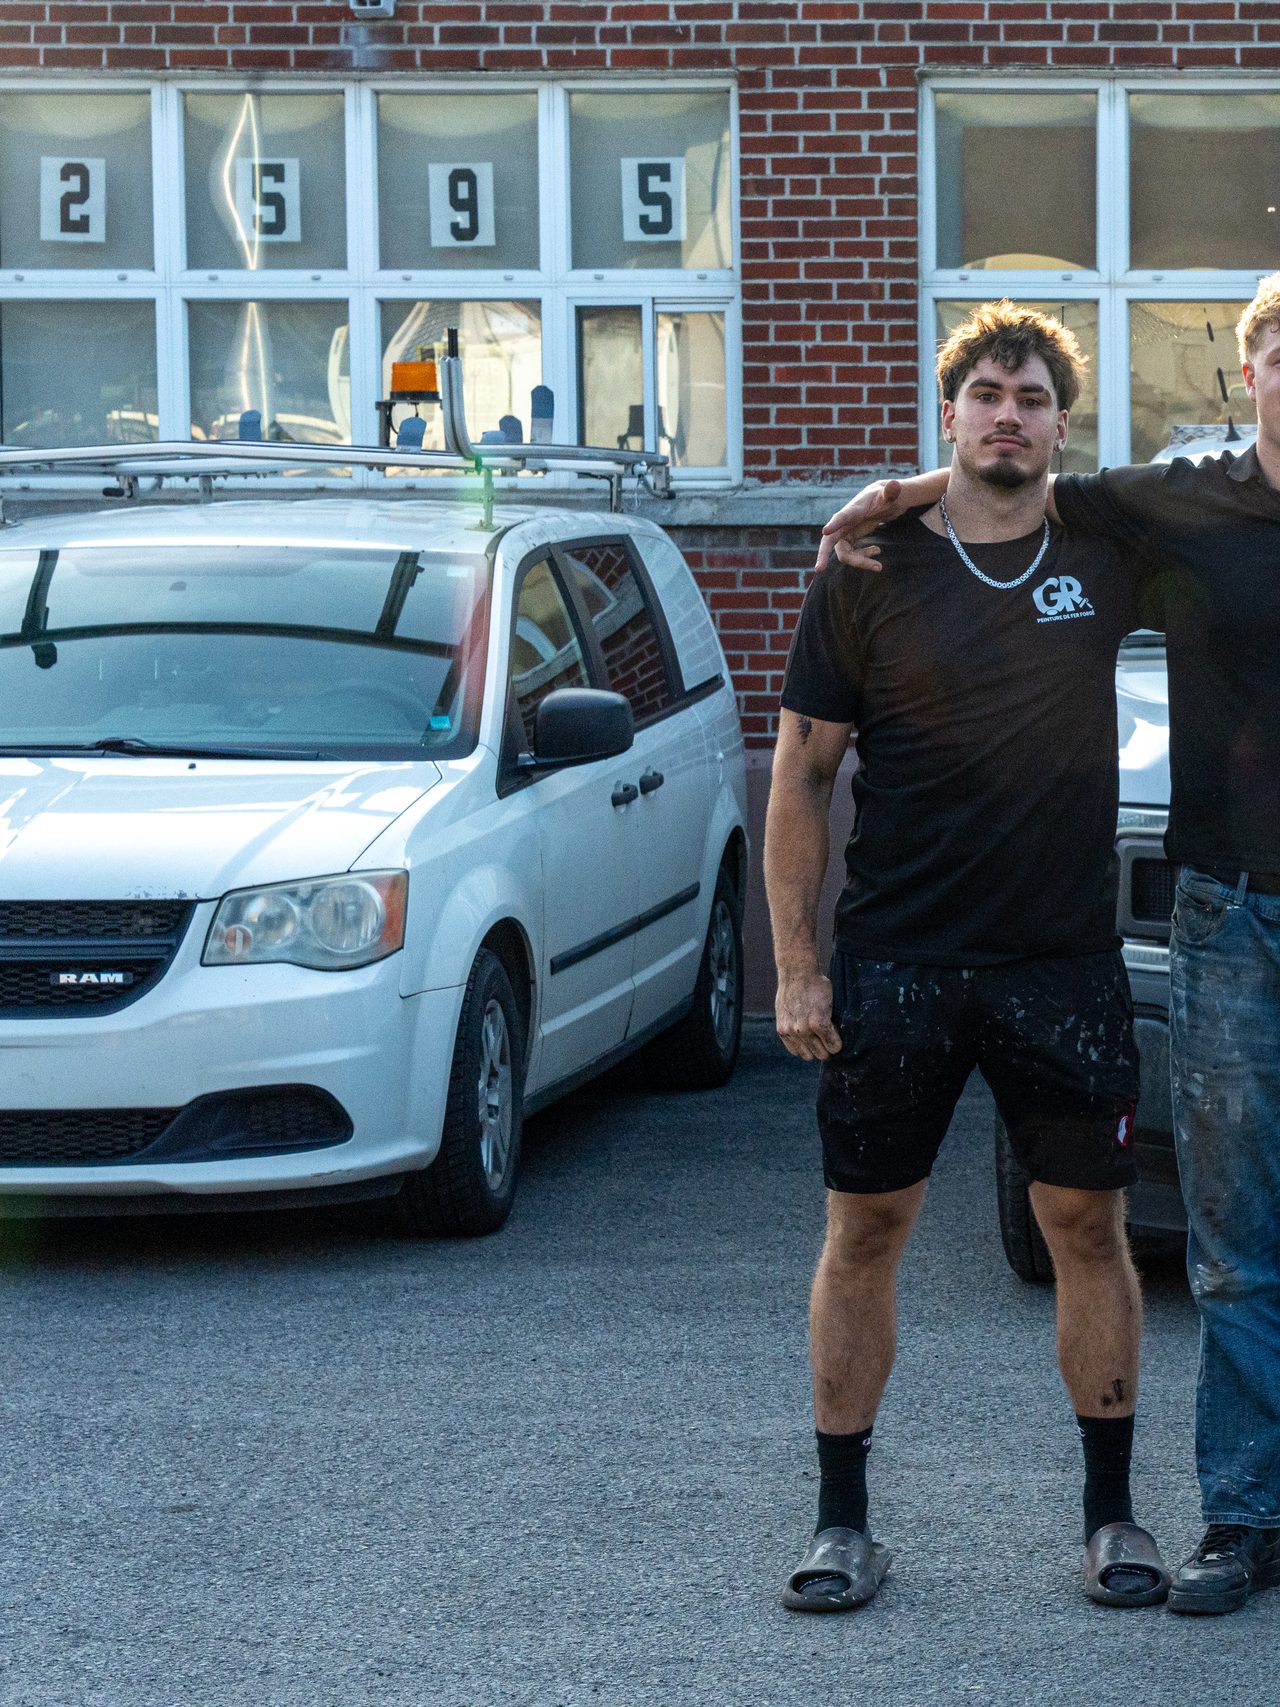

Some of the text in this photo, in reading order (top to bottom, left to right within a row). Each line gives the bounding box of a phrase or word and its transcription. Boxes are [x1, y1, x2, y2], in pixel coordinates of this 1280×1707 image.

[60, 163, 673, 242] 2 5 9 5
[1032, 575, 1084, 616] GR
[1037, 615, 1063, 624] PEINTURE
[59, 972, 124, 984] RAM
